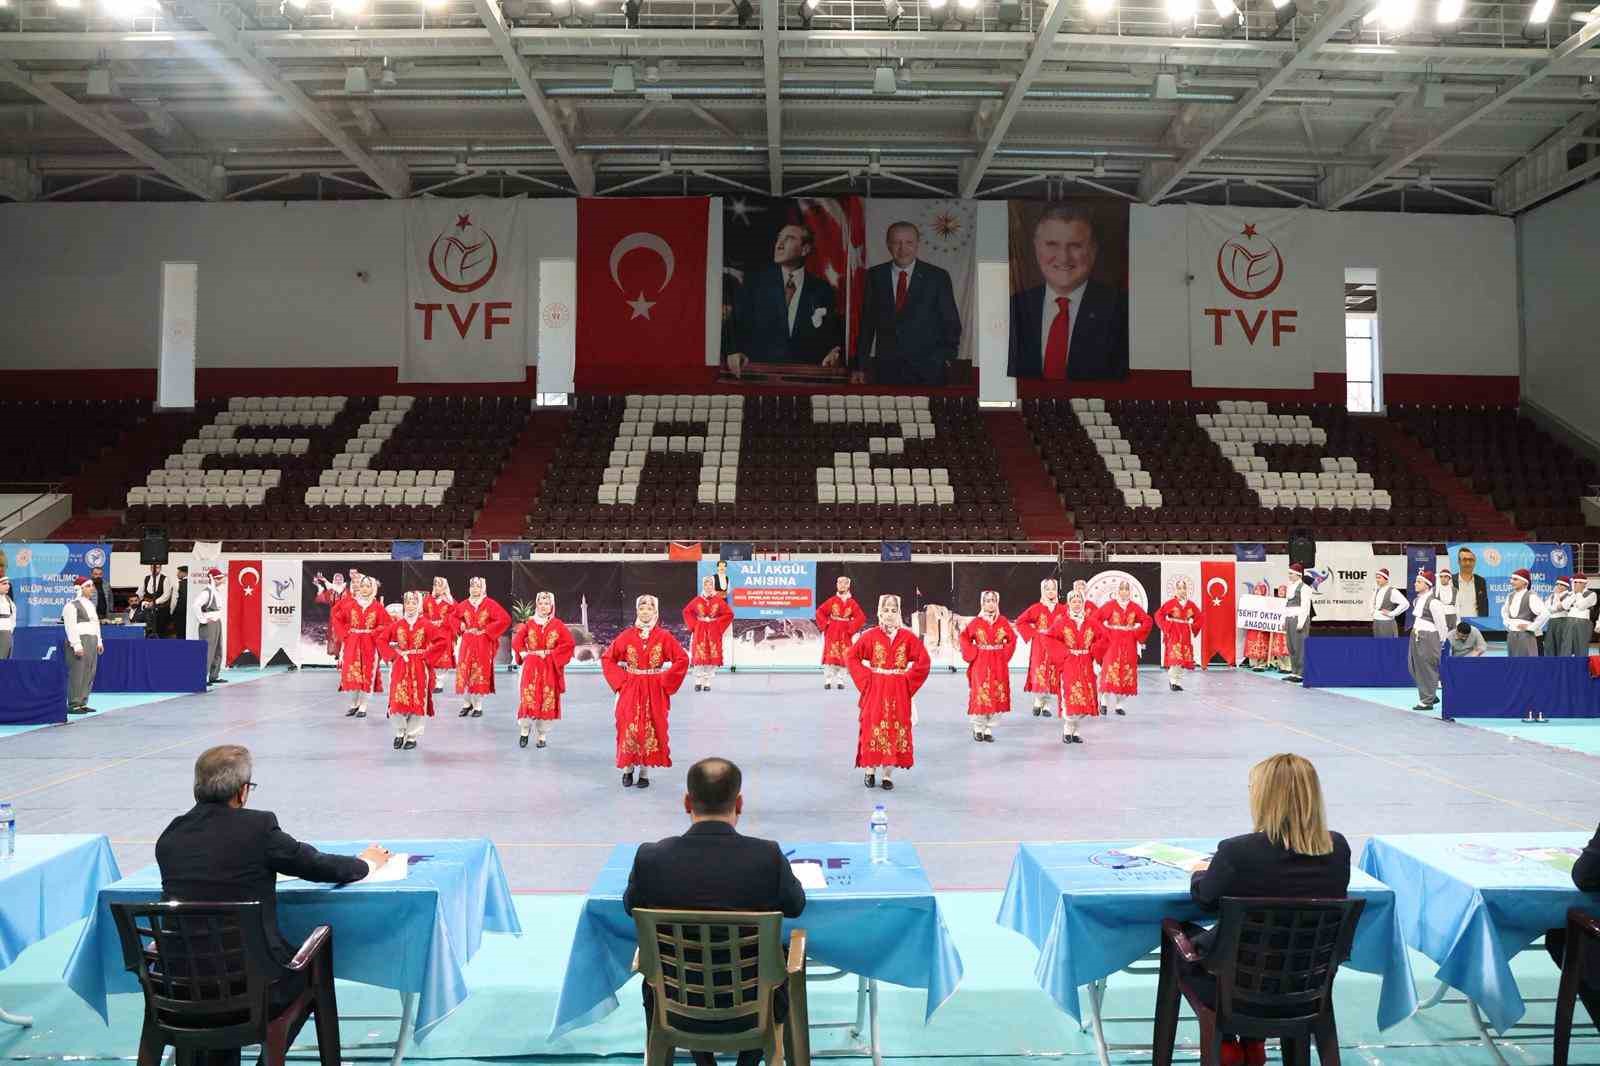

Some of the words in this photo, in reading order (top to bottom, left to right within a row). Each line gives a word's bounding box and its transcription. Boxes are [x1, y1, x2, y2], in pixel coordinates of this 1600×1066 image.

[414, 302, 512, 340] TVF
[1204, 308, 1298, 347] TVF
[1337, 570, 1367, 580] THOF
[267, 605, 296, 615] THOF
